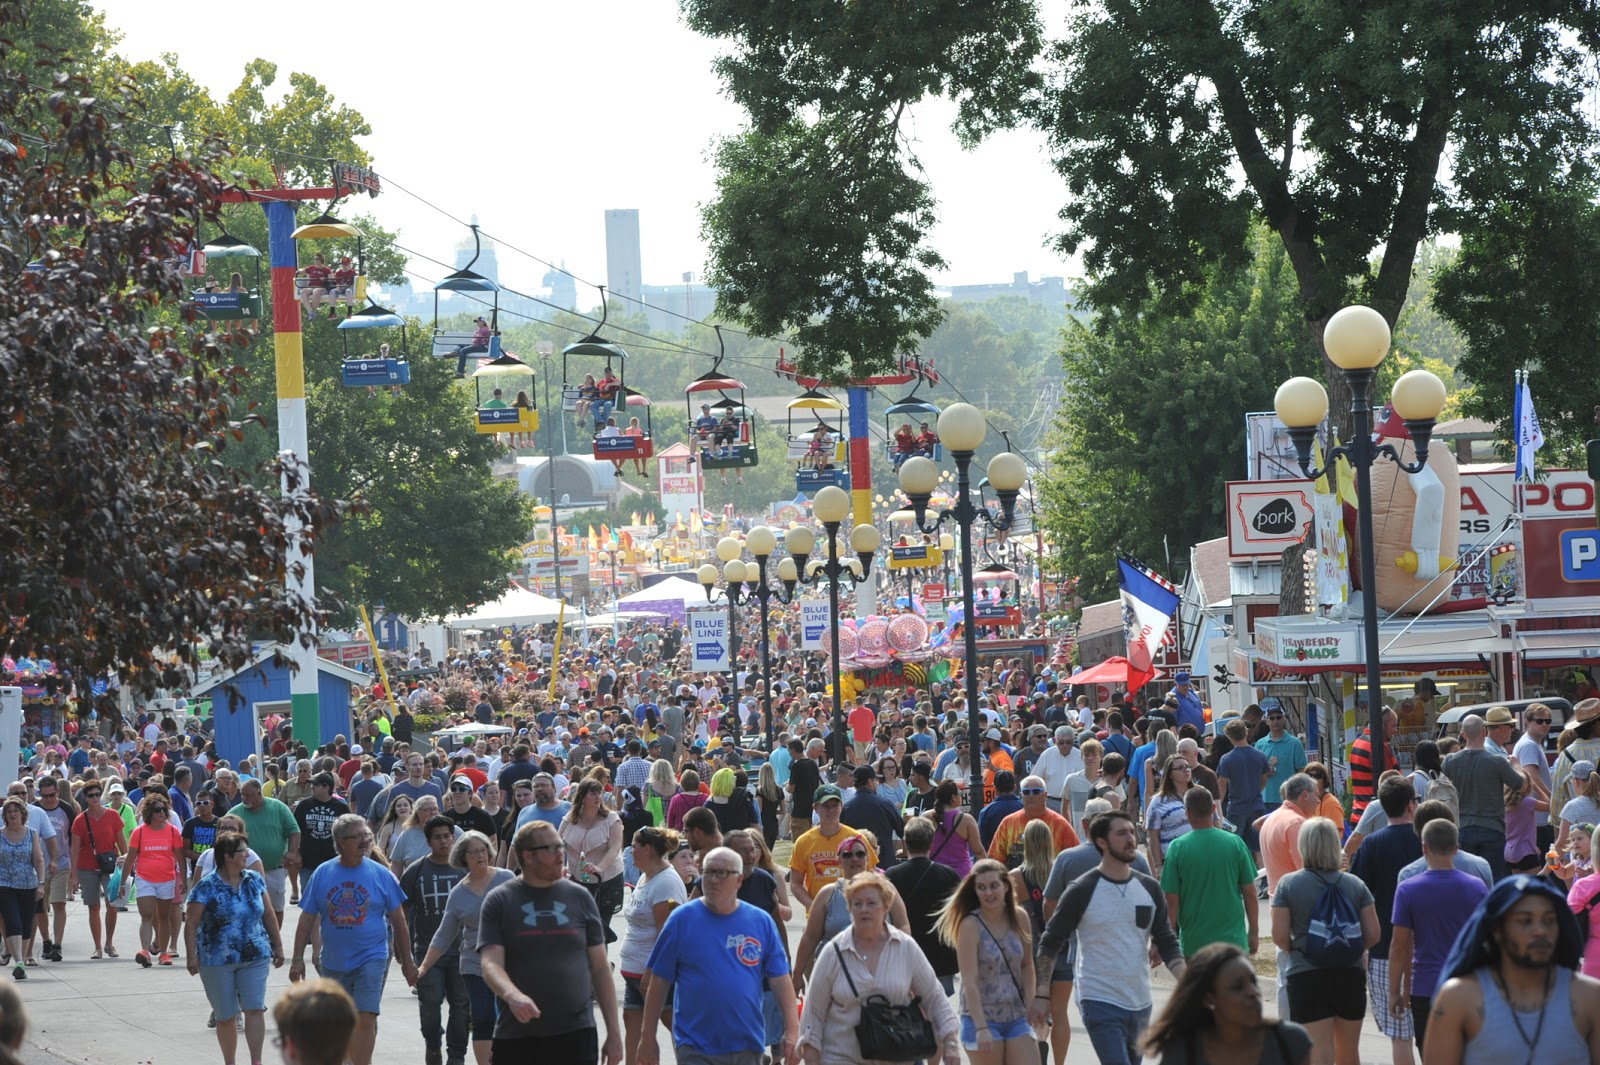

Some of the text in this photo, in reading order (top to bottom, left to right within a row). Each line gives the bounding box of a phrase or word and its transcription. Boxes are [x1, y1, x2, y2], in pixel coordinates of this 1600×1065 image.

[241, 307, 250, 315] 14
[1513, 482, 1595, 513] PO
[1257, 507, 1295, 530] pork
[803, 605, 829, 614] BLUE
[806, 614, 828, 622] LINE
[695, 620, 725, 628] BLUE
[698, 629, 723, 638] LINE
[1282, 637, 1341, 648] STRAWBERRY
[310, 806, 335, 816] TEXAS
[194, 827, 215, 836] HIGH
[193, 836, 214, 845] LIGHT
